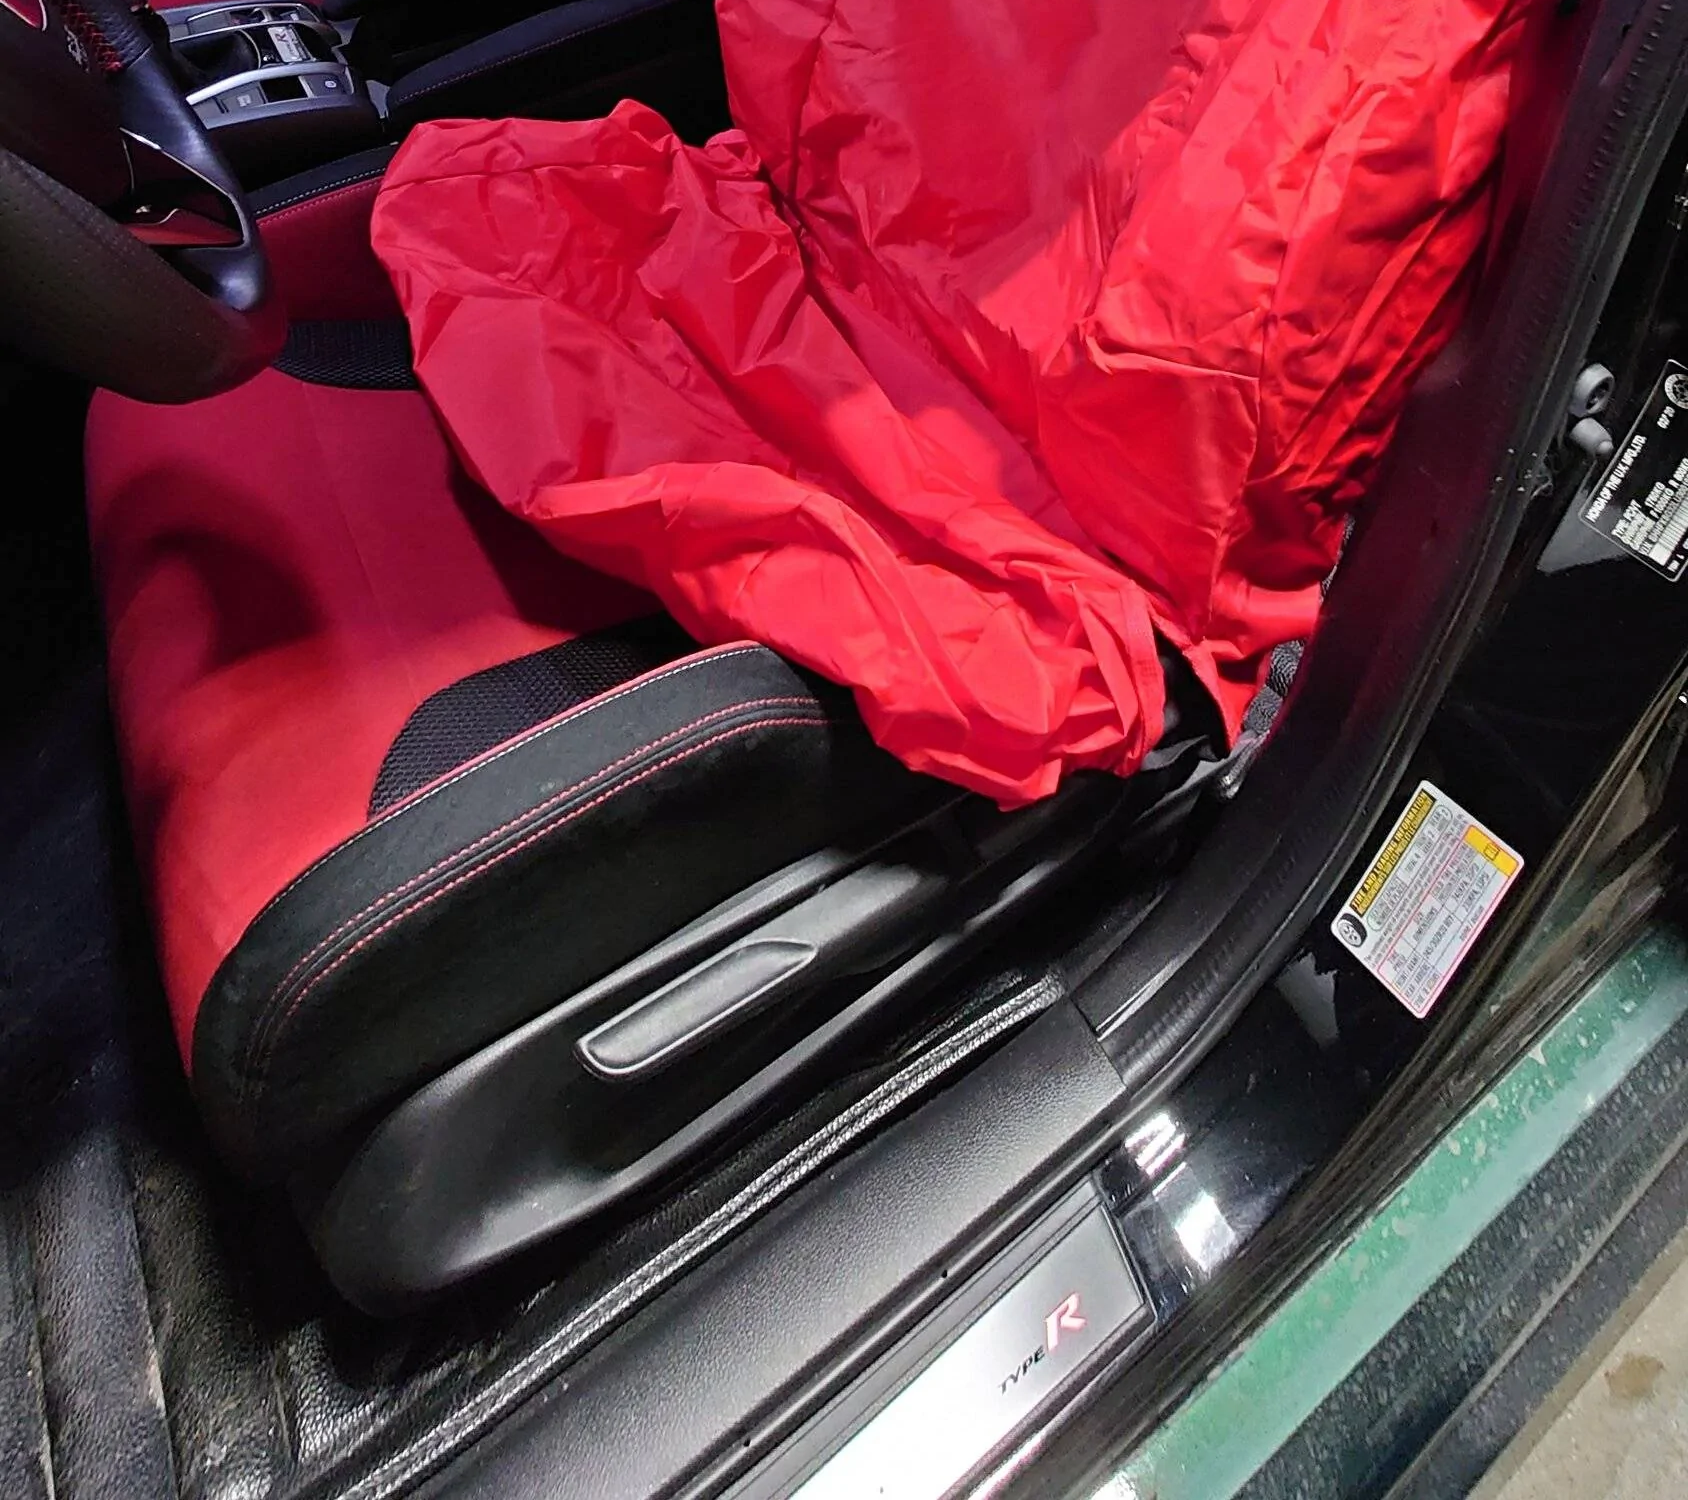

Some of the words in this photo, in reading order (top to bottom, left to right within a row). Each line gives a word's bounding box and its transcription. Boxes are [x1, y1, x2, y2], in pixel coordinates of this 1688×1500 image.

[1598, 485, 1614, 501] OF
[1604, 472, 1622, 492] THE
[1585, 494, 1608, 523] HONDA
[1352, 892, 1366, 910] TIRE
[1362, 873, 1377, 893] AND
[1375, 840, 1397, 875] LOADING
[1394, 790, 1426, 842] INFORMATION
[997, 1345, 1046, 1396] TYPE
[1043, 1291, 1088, 1355] R
